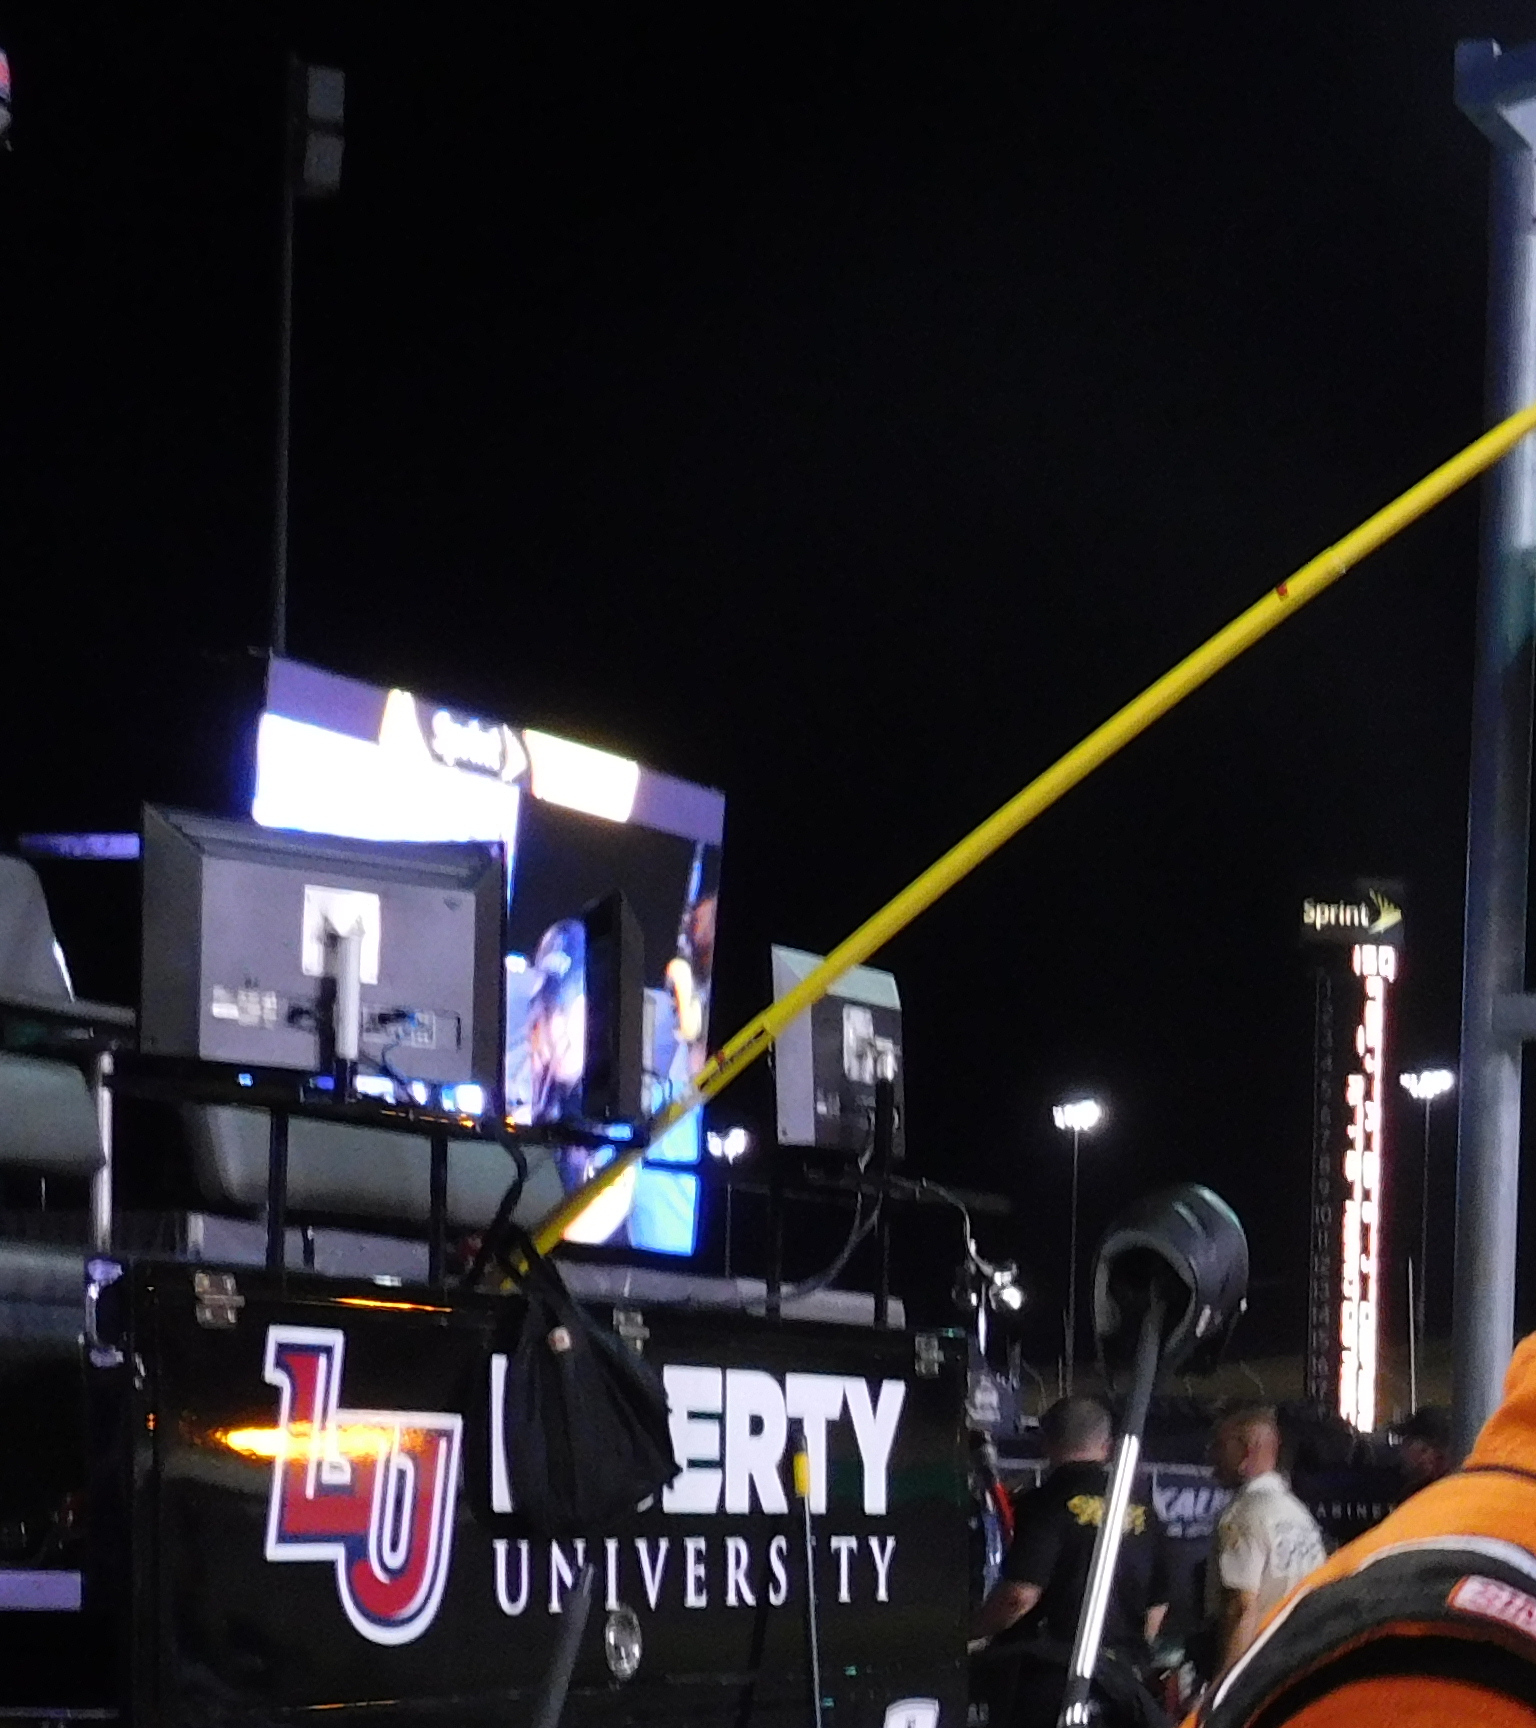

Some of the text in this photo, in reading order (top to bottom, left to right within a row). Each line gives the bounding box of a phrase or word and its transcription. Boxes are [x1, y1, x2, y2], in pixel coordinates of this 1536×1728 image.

[1302, 897, 1370, 931] Sprint
[491, 1353, 906, 1516] ERTY
[492, 1534, 896, 1617] UNIVERSTY
